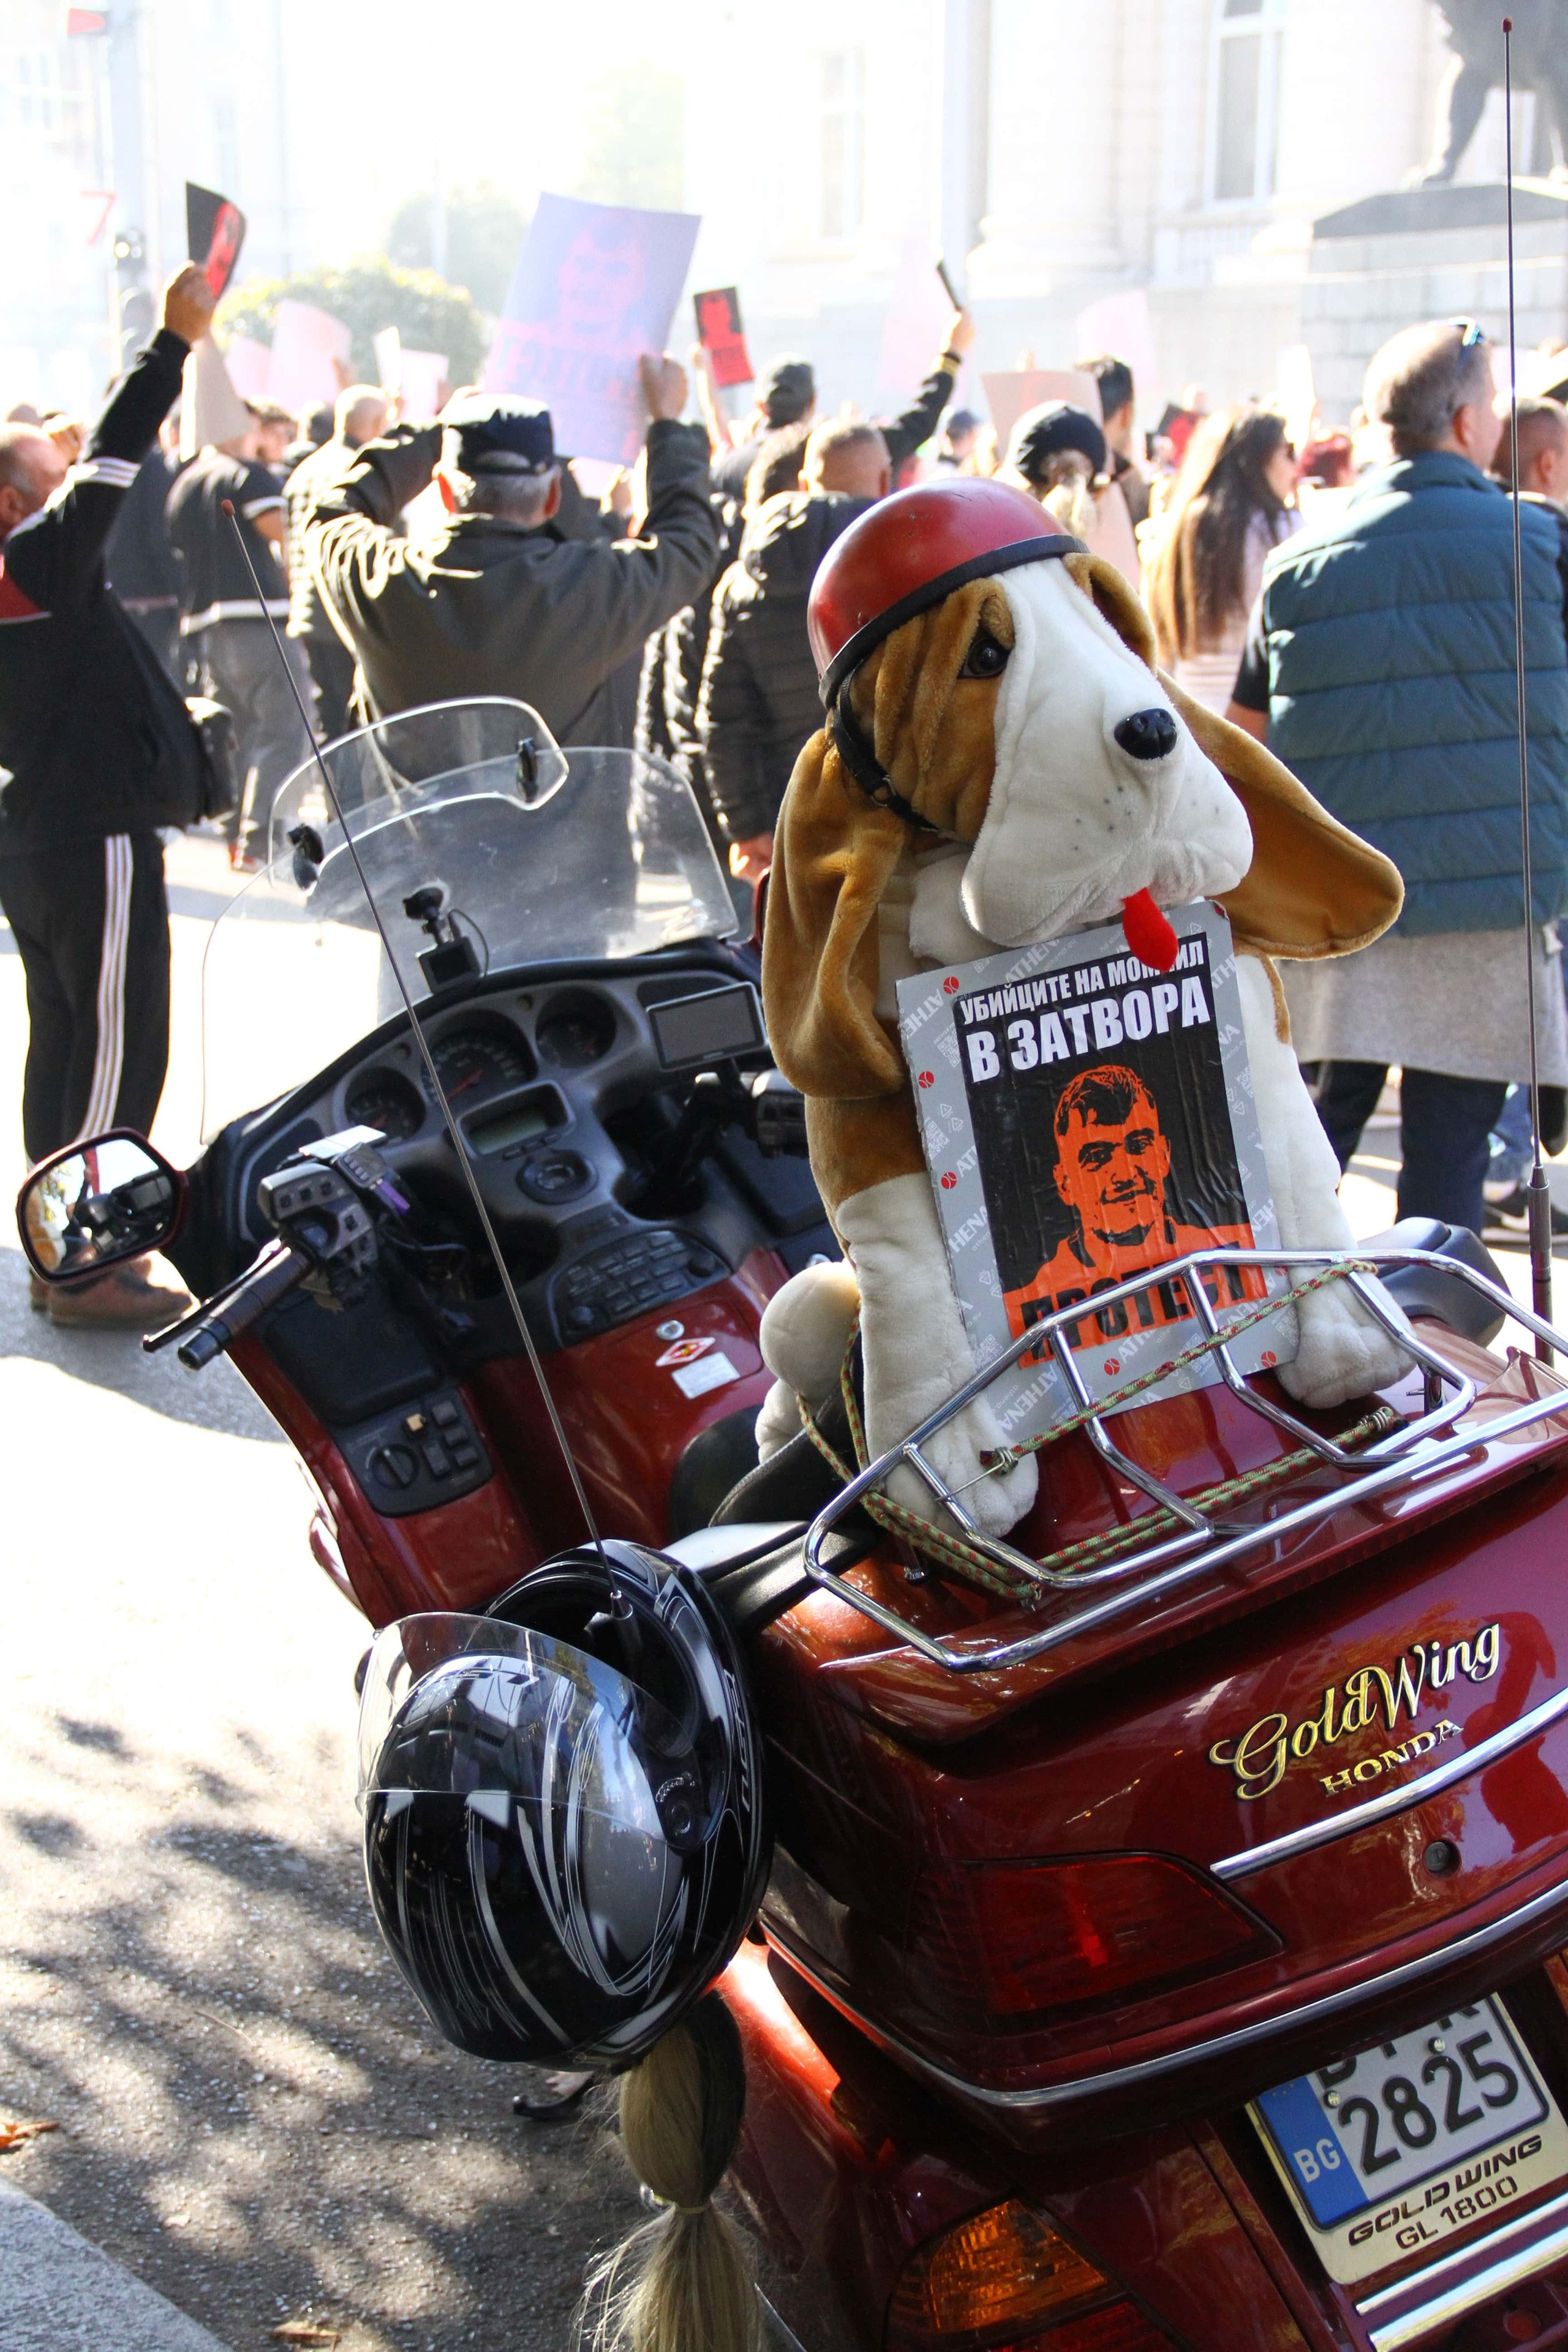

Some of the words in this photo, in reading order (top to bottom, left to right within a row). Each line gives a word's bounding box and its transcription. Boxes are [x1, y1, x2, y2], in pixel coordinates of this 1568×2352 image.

[960, 973, 1071, 1025] УБИЙЦИТЕ
[1074, 965, 1105, 995] НА
[1107, 940, 1204, 987] МОИЛ
[966, 1030, 1000, 1083] В
[1008, 975, 1211, 1071] ЗАТВОРА
[1319, 1719, 1464, 1797] HONDA
[1338, 2031, 1520, 2176] 2825
[1293, 2138, 1341, 2183] BG
[1395, 2221, 1438, 2250] GL
[1439, 2175, 1518, 2225] 1800
